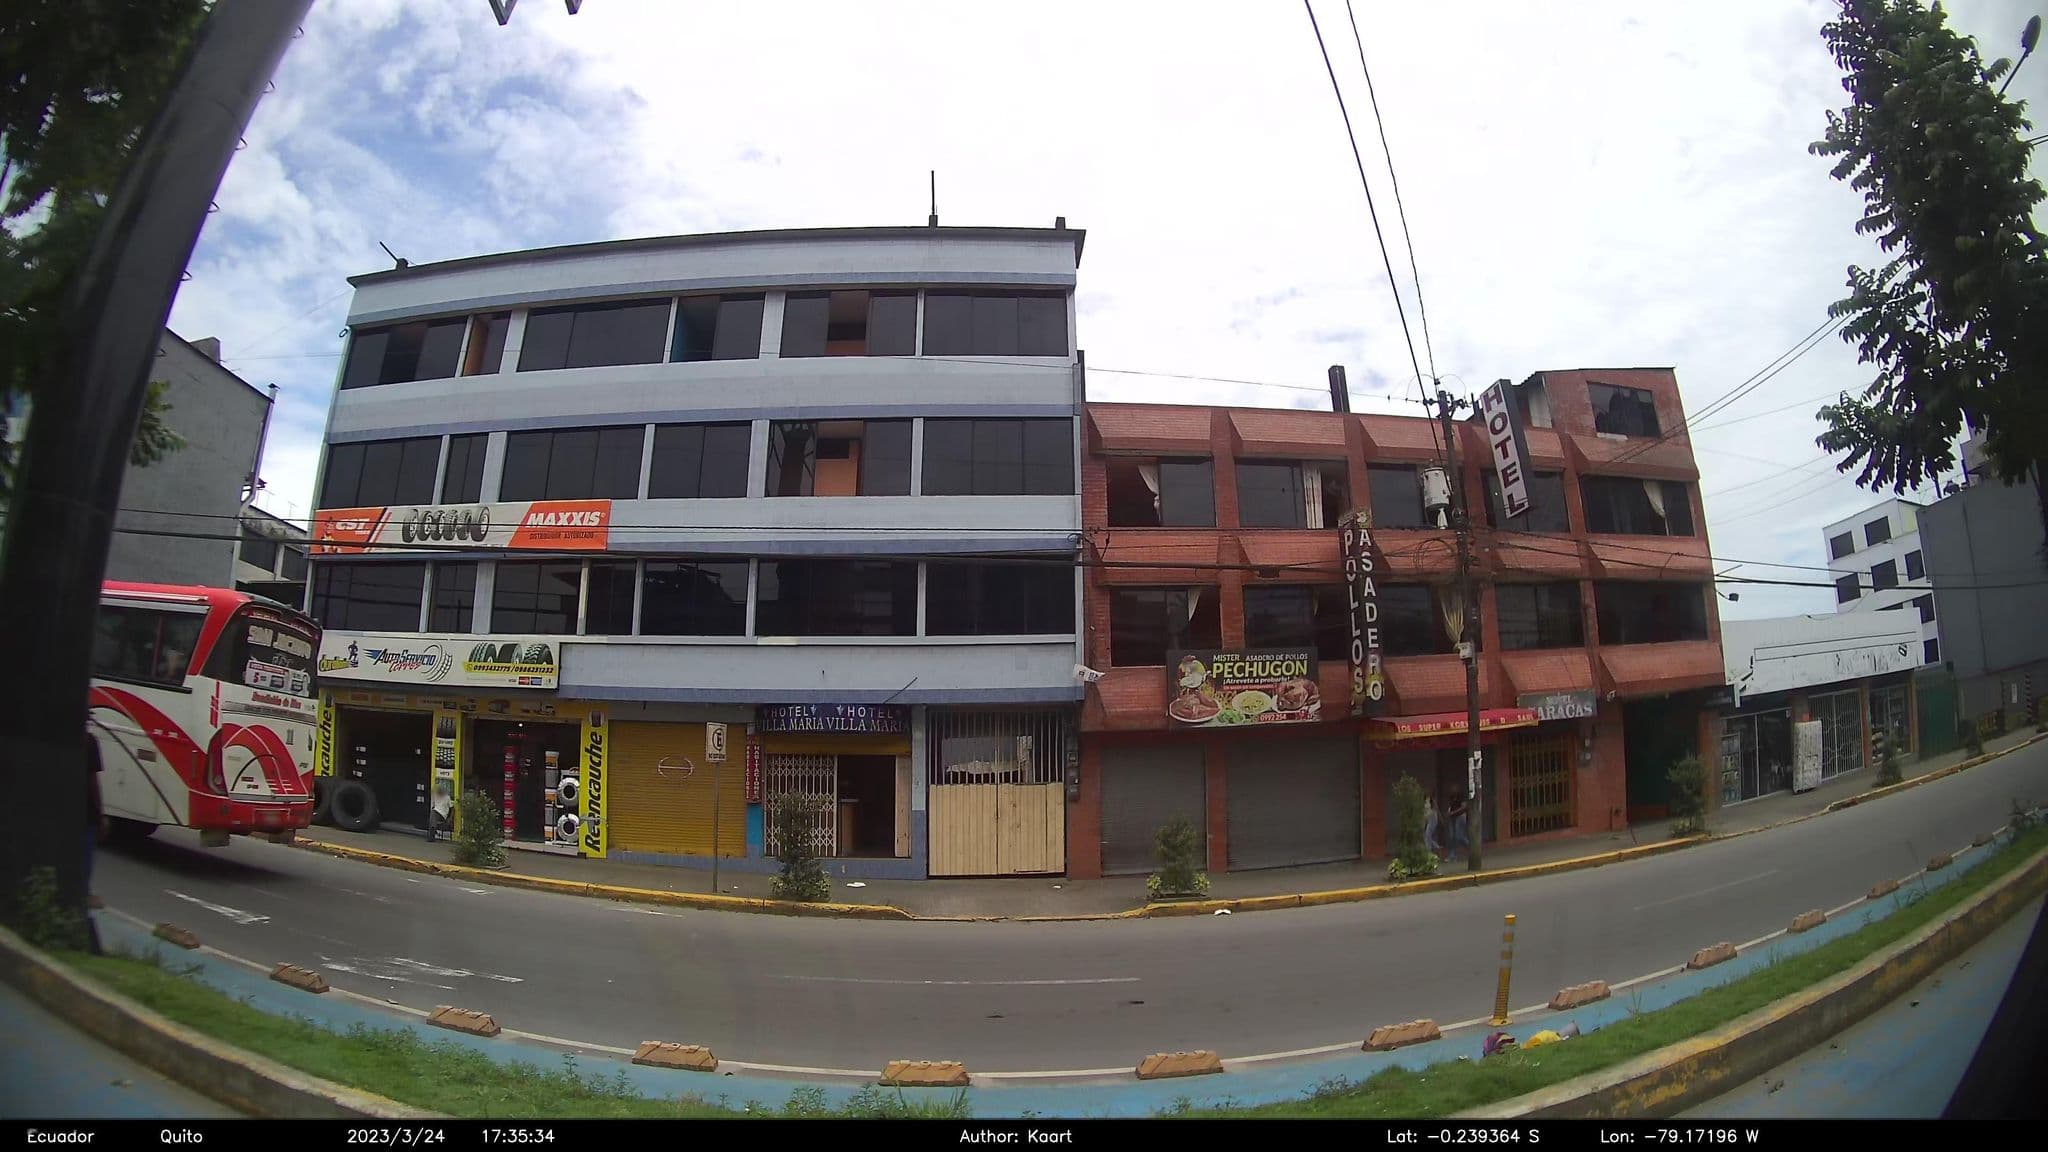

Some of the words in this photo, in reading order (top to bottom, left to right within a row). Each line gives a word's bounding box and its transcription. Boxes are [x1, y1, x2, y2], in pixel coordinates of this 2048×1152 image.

[1482, 384, 1525, 515] HOTEL
[525, 511, 601, 528] MAXXIS
[1344, 529, 1364, 694] POLLOS
[1359, 528, 1383, 701] ASADERO
[1213, 654, 1240, 662] MISTER
[771, 705, 809, 717] HOTEL
[847, 706, 894, 719] HOTEL
[761, 718, 787, 731] ILLA
[788, 717, 825, 731] MARIA
[826, 717, 866, 731] VILLA
[869, 718, 902, 732] MARI
